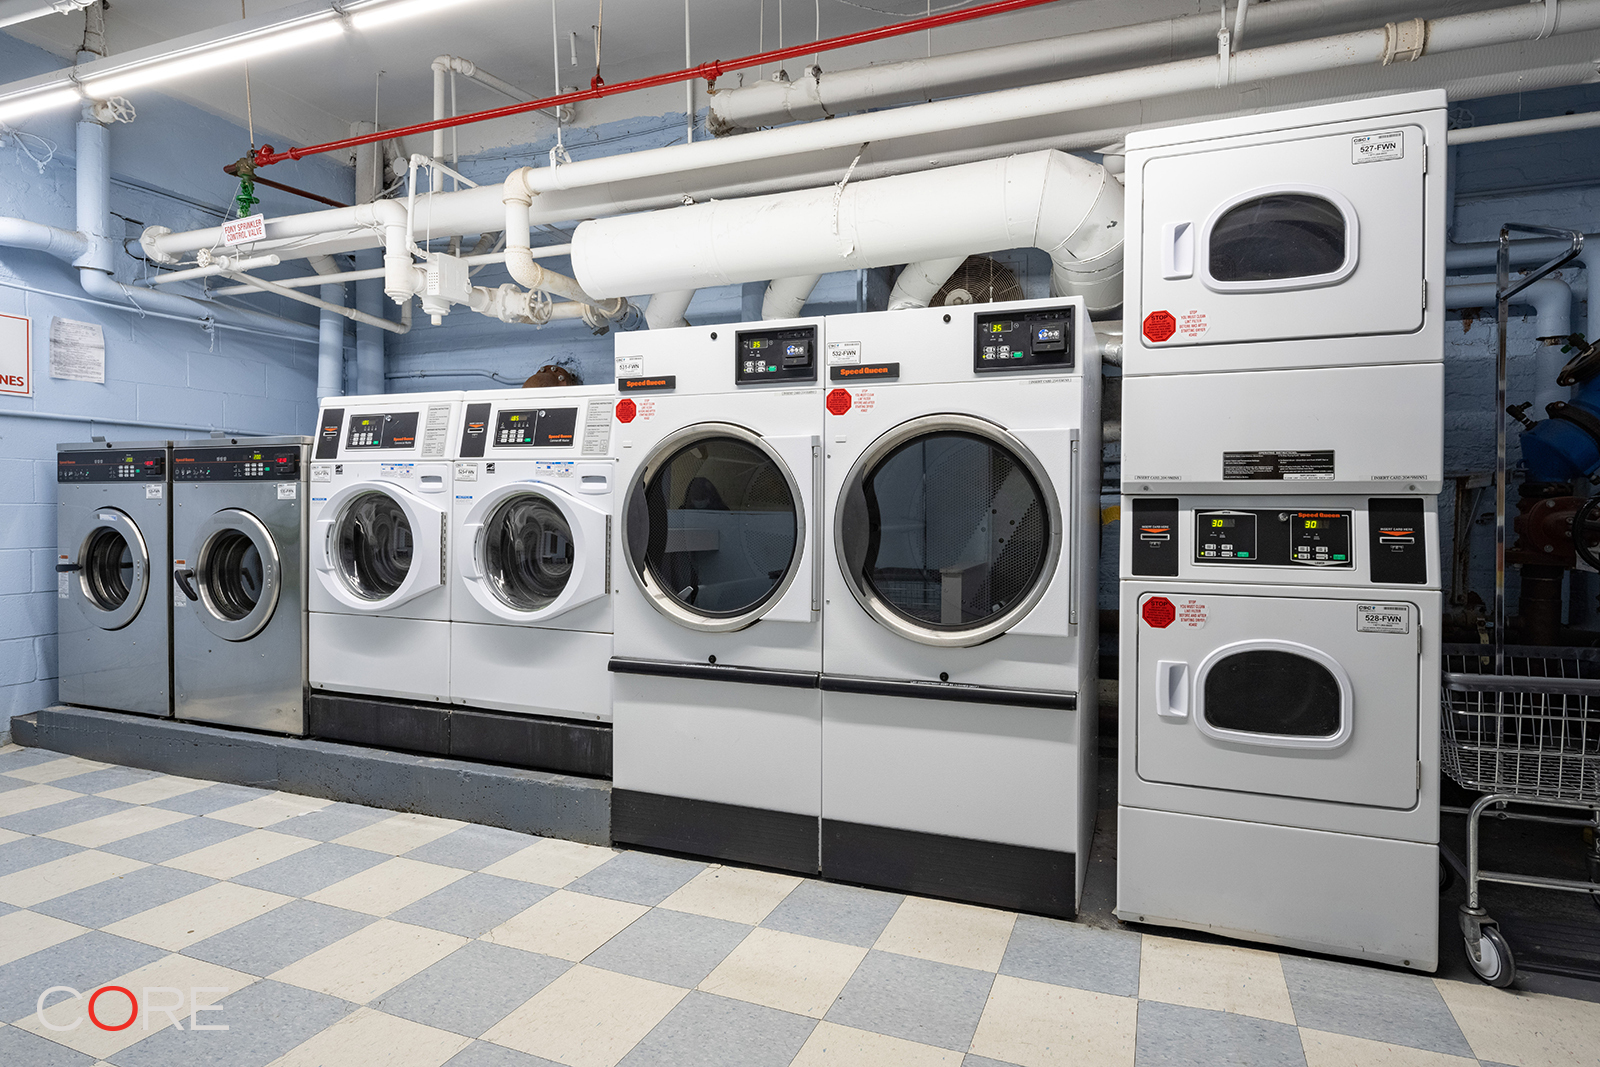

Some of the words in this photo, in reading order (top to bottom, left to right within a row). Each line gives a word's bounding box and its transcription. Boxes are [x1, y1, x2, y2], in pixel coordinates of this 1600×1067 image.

[1360, 142, 1396, 153] 527-FWN
[237, 219, 261, 231] SPRINKLER
[227, 231, 247, 241] CONTROL
[248, 227, 261, 236] VALVE
[992, 324, 1002, 332] 35
[840, 368, 864, 376] Speed
[626, 380, 646, 388] Speed
[1211, 519, 1223, 527] 30
[1304, 520, 1317, 528] 30
